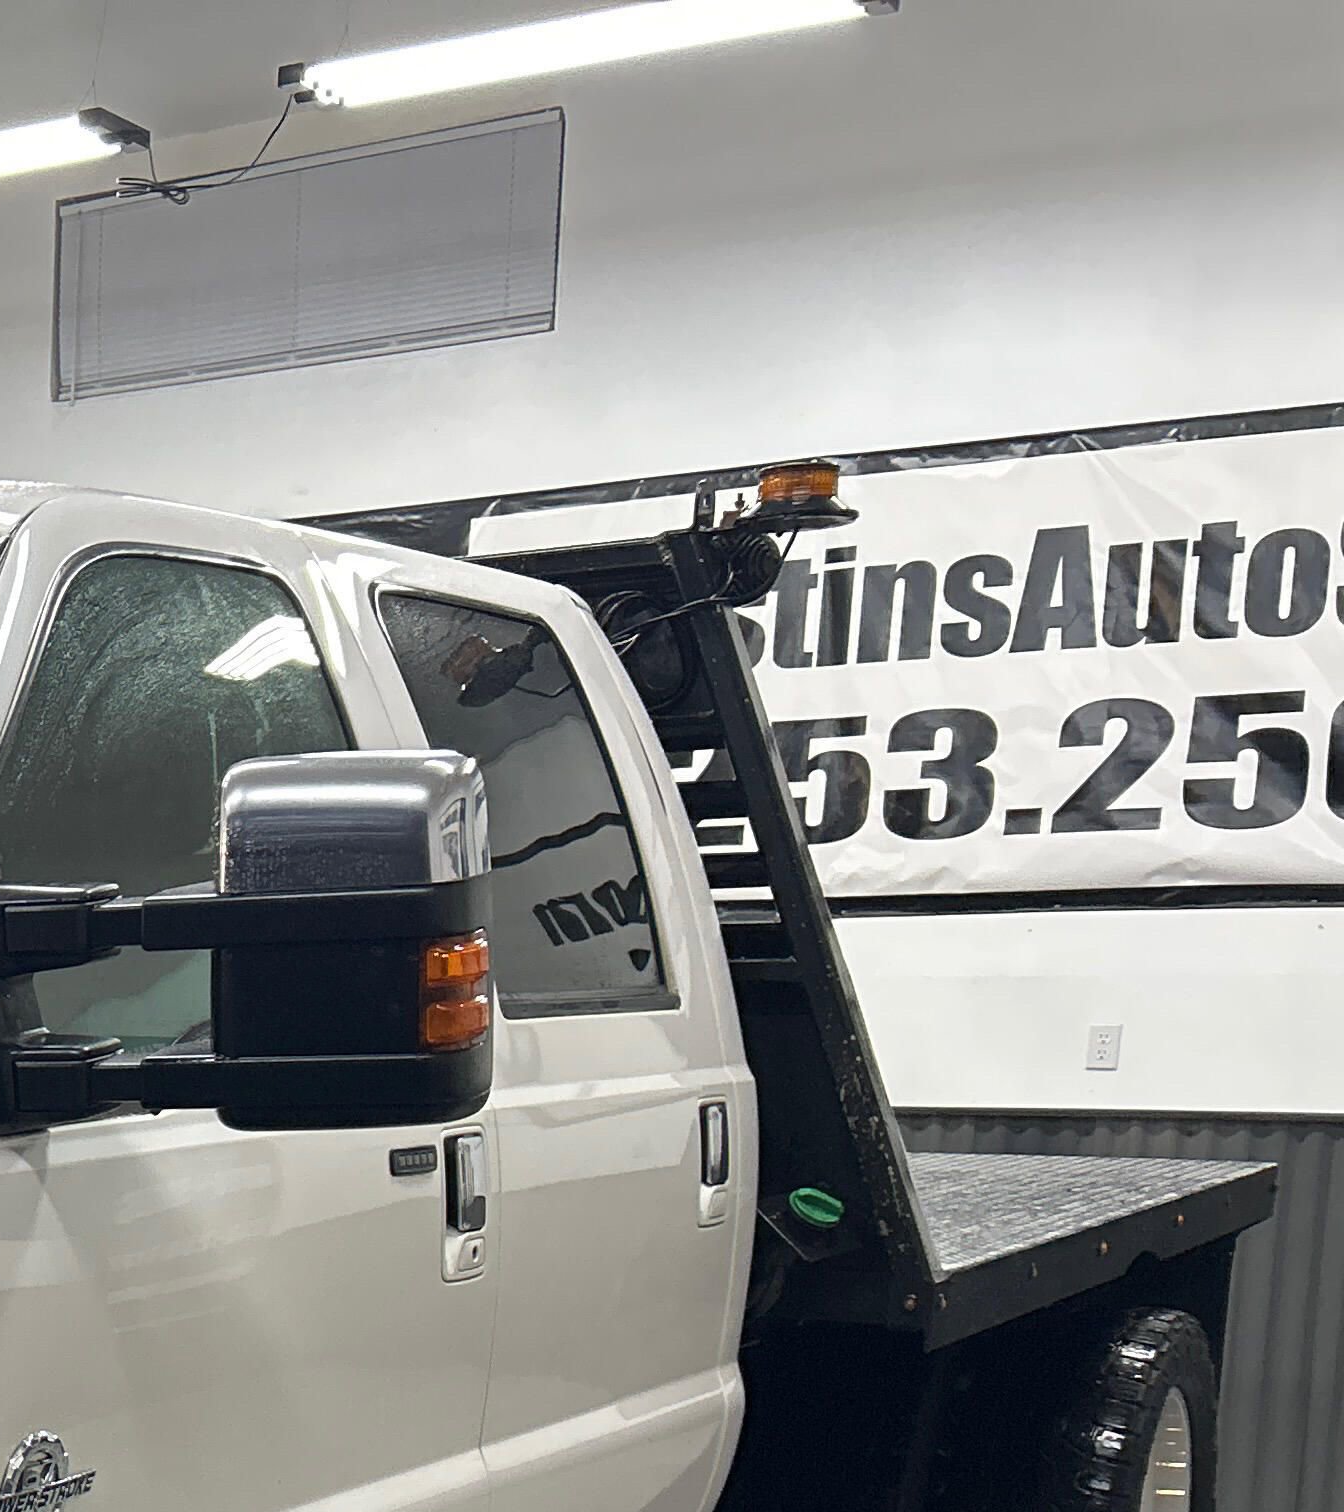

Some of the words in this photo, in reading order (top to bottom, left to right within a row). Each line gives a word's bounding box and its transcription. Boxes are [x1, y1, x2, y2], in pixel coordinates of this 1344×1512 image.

[732, 520, 1344, 669] tinsAuto
[669, 690, 1344, 850] 53.25
[36, 1471, 97, 1509] STROKE
